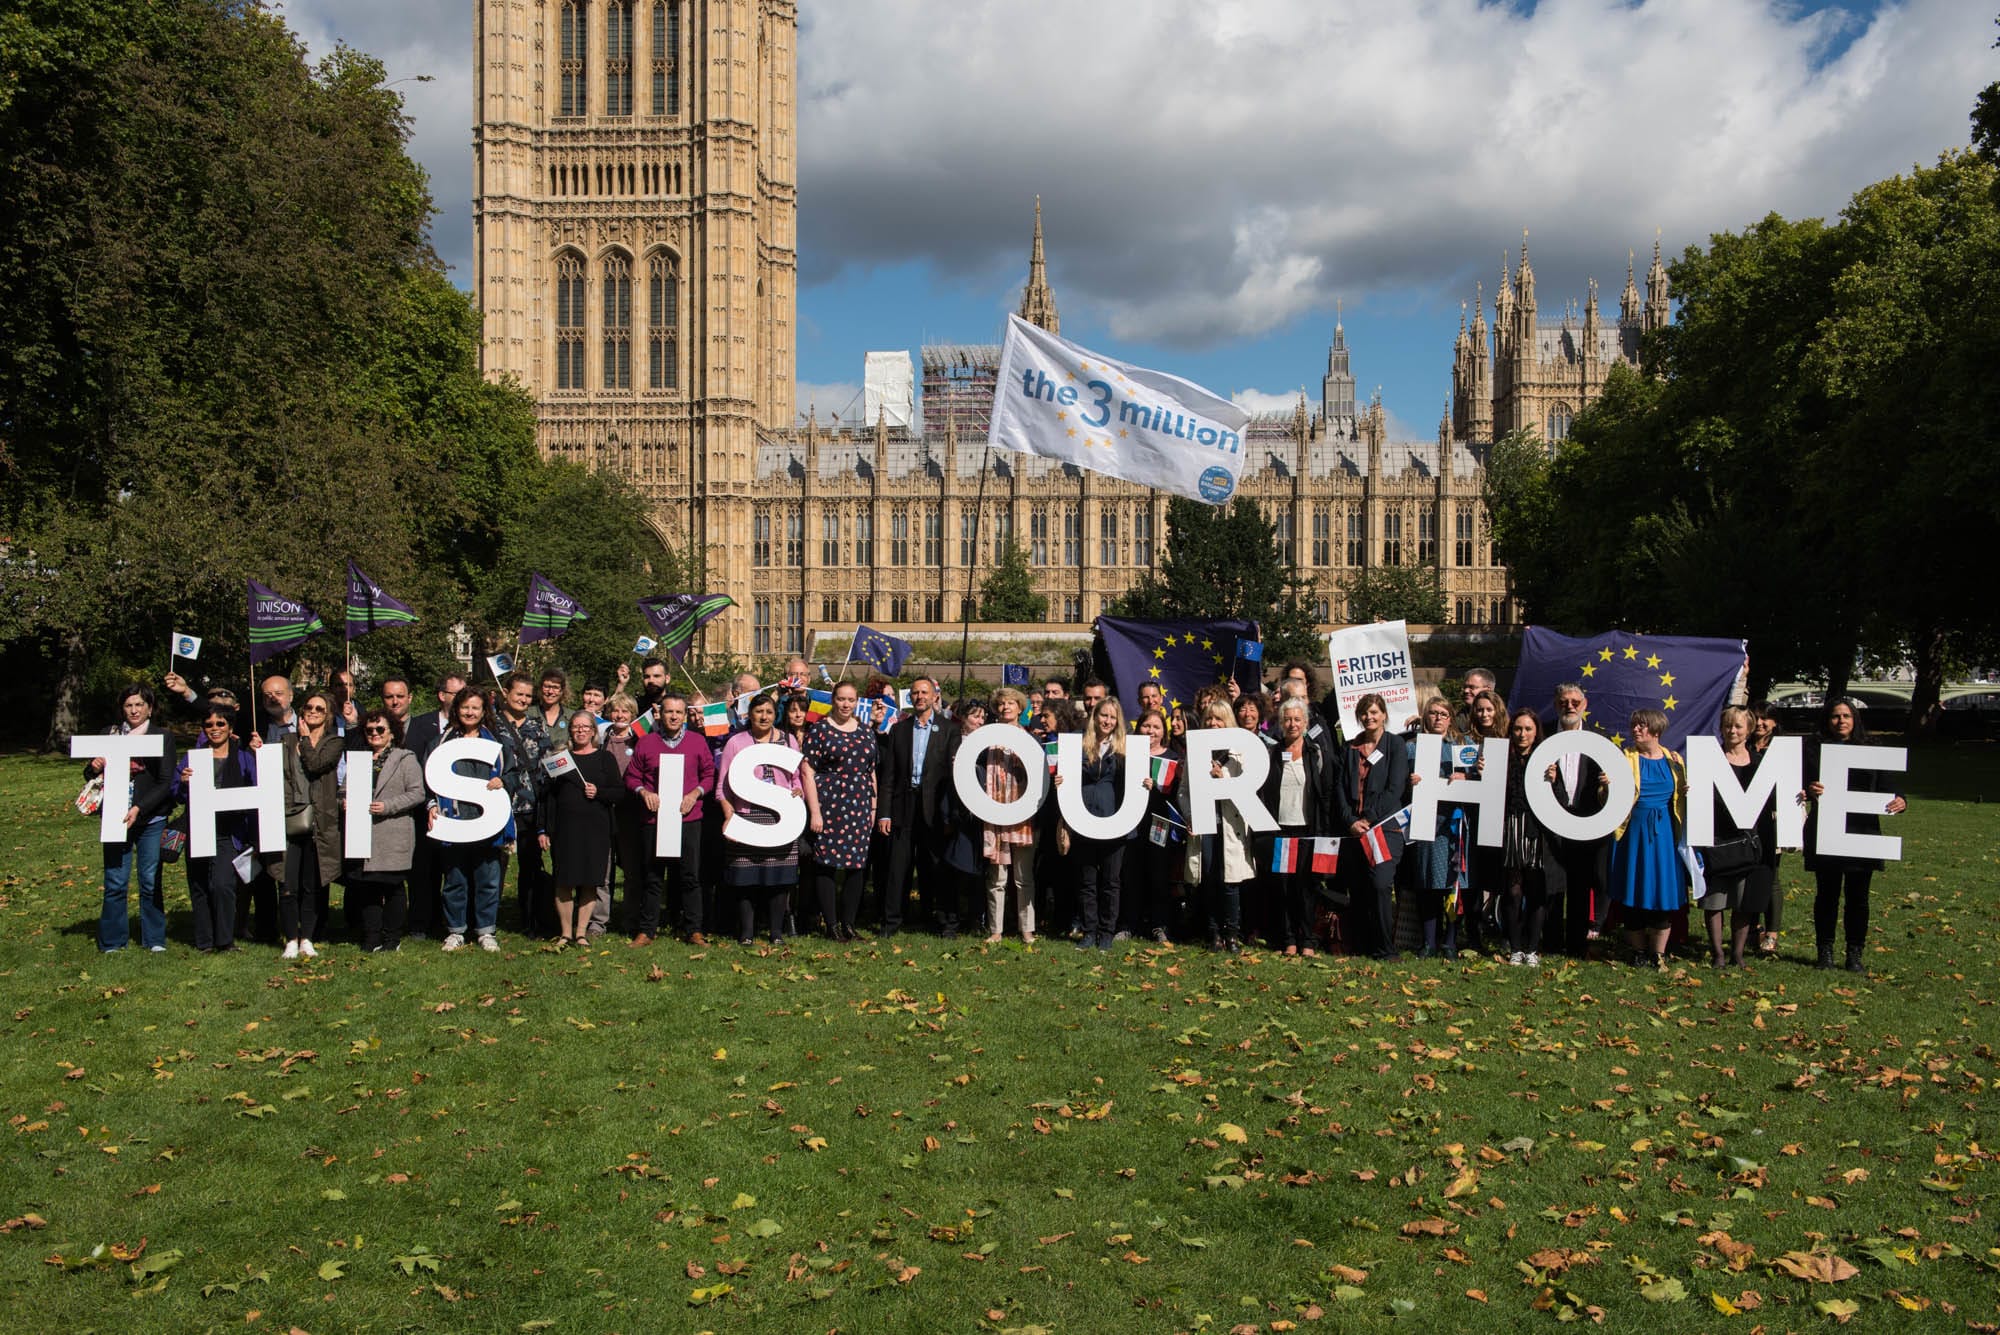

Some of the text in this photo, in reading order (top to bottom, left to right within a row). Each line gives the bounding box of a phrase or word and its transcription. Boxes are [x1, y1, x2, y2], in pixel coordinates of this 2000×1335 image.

[1022, 368, 1239, 454] the 3 million
[256, 601, 301, 613] UNISON
[536, 590, 573, 609] UNISON
[1337, 651, 1405, 673] BRITISH
[1340, 667, 1408, 687] IN EUROPE
[1342, 695, 1356, 703] THE
[71, 723, 1907, 860] THIS IS OUR HOME
